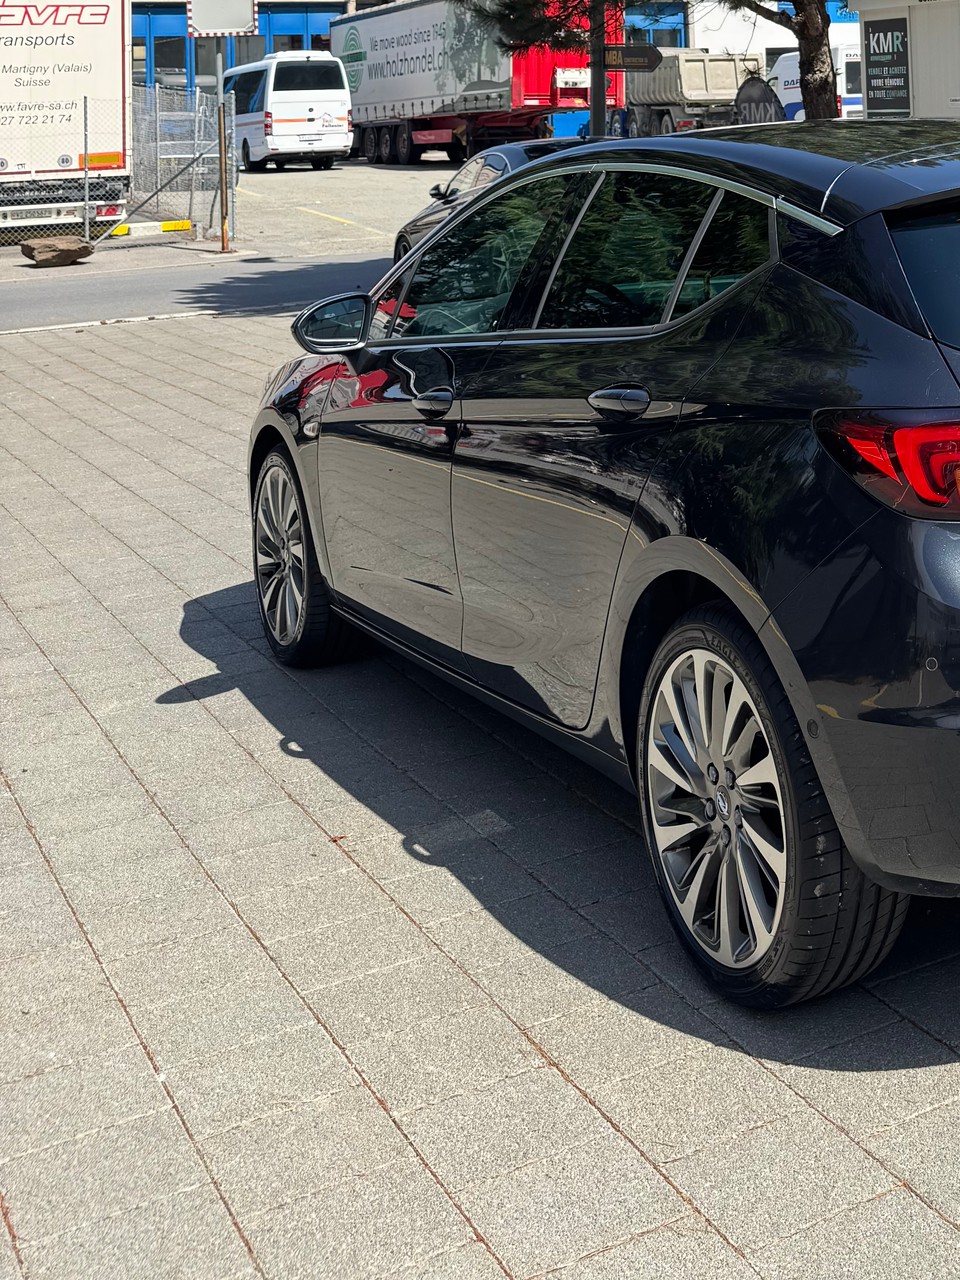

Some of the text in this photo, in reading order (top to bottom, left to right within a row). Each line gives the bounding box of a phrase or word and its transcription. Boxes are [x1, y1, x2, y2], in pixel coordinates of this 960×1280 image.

[369, 36, 378, 52] We
[379, 36, 395, 50] move
[396, 29, 412, 47] wood
[413, 28, 431, 44] since
[869, 31, 904, 54] KMR
[604, 51, 623, 65] MBA
[1, 63, 92, 76] Martigny (Valais)
[14, 77, 51, 88] Suisse
[0, 114, 72, 126] 27 722 21 74
[710, 635, 740, 667] EAGLE
